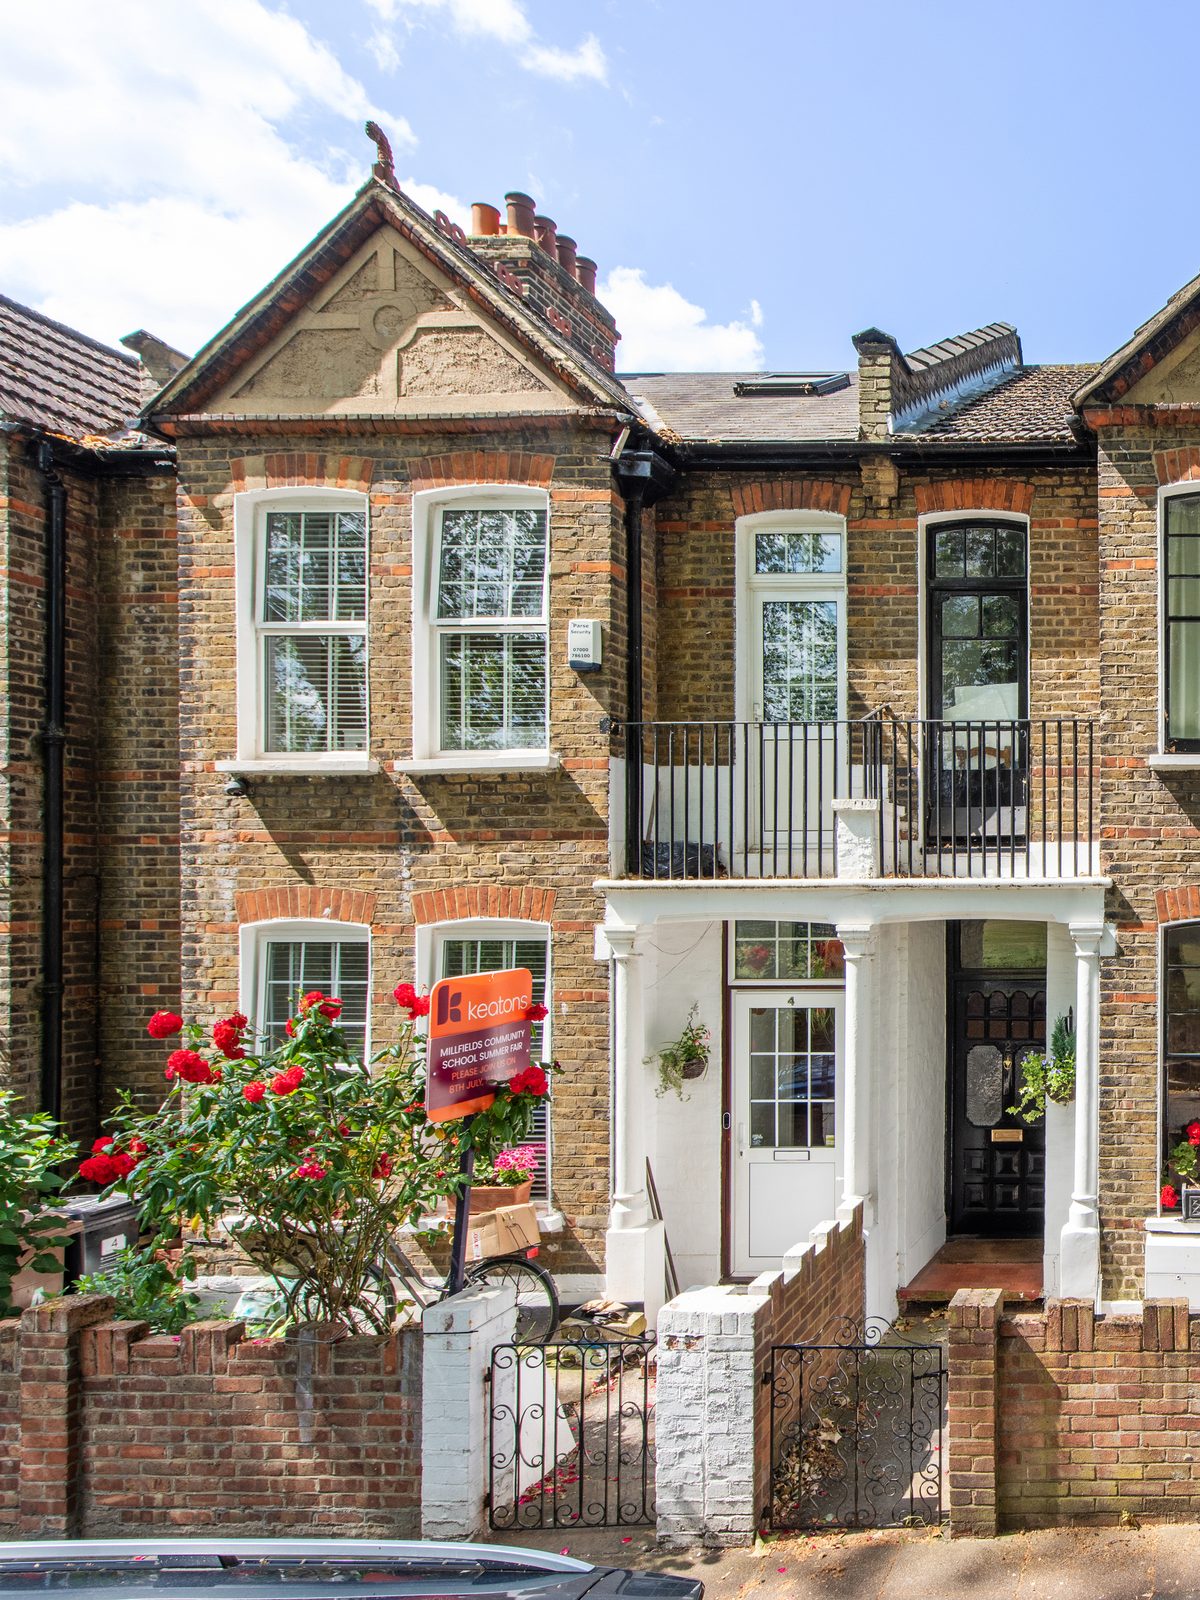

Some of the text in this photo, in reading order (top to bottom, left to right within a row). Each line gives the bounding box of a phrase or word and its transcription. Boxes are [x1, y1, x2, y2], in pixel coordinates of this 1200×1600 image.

[467, 995, 528, 1021] keatons
[788, 996, 794, 1006] 4
[440, 1030, 525, 1057] MILLFIELDS COMMUNITY
[442, 1041, 523, 1070] SCHOOL SUMMER FAIR
[451, 1067, 479, 1080] PLEASE
[480, 1063, 496, 1074] JOIN
[449, 1083, 465, 1094] 8TH
[111, 1237, 118, 1248] 4
